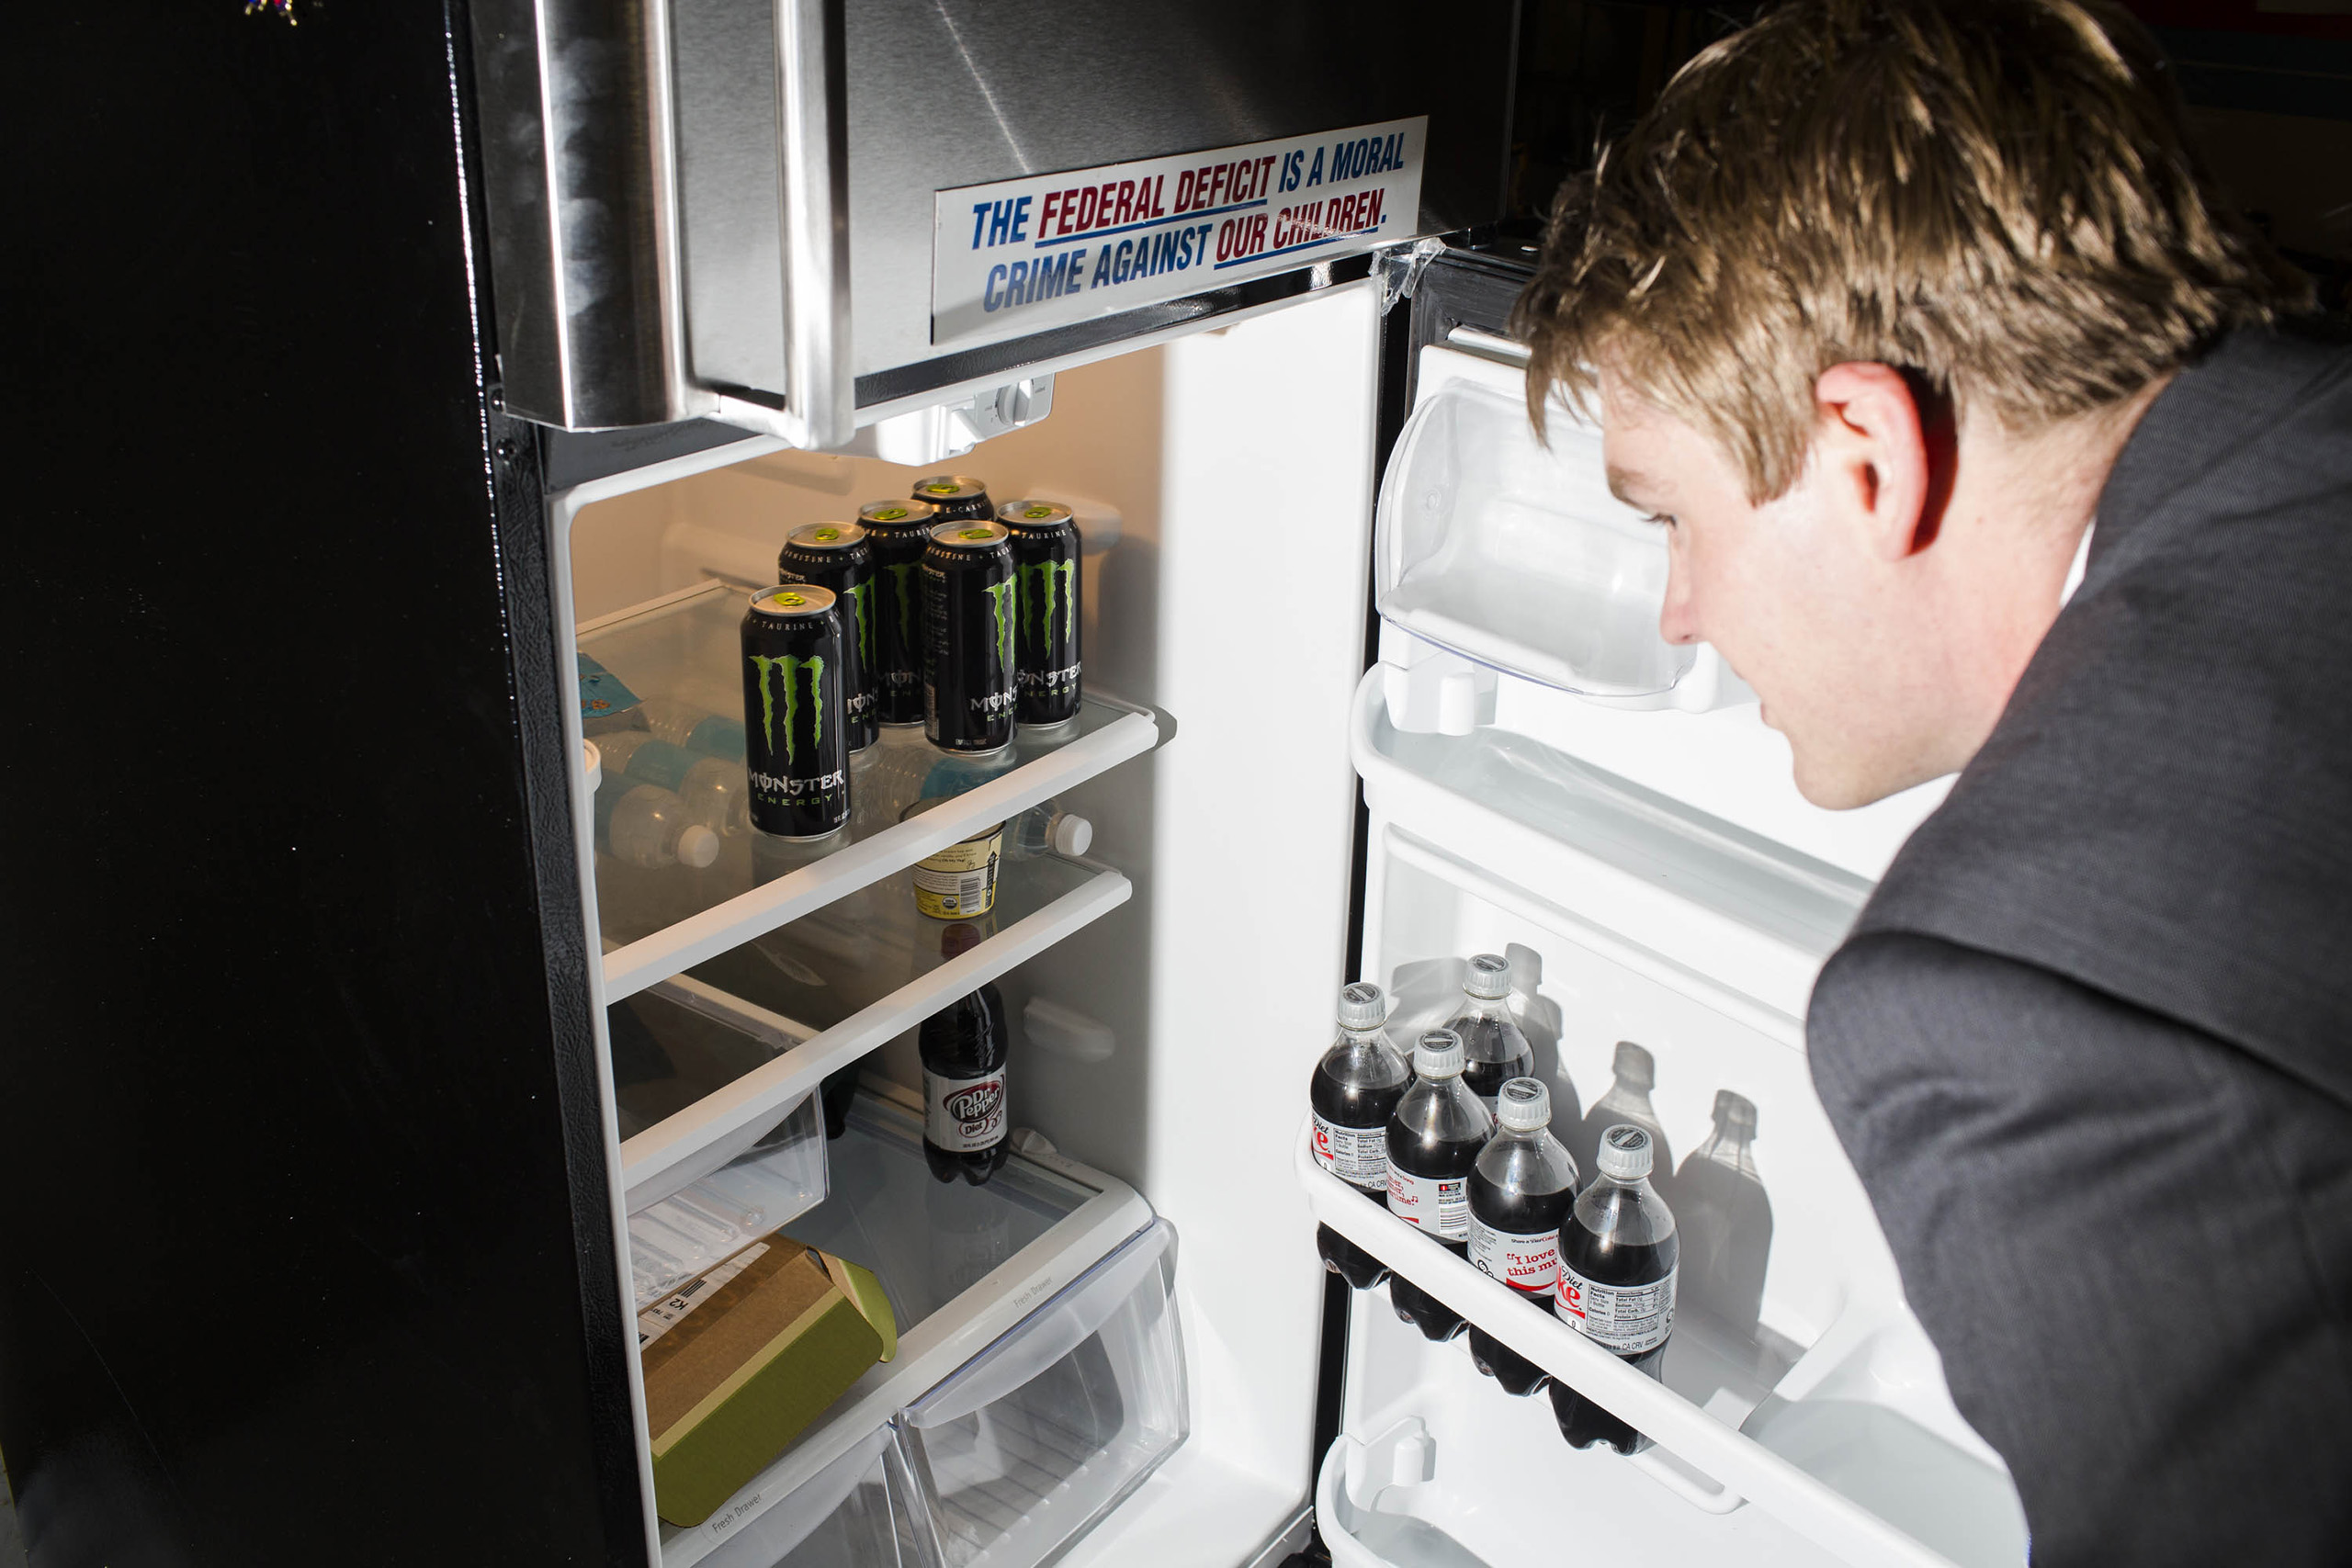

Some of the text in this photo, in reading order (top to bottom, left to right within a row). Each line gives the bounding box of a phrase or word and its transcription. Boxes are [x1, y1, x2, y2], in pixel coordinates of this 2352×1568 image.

[972, 132, 1405, 250] THE FEDERAL DEFICIT IS A MORAL
[983, 188, 1386, 312] CRIME AGAINST OUR CHILDREN.
[1022, 529, 1067, 539] TAURINE
[762, 620, 813, 631] TAURINE
[1017, 660, 1081, 688] ONSTER
[970, 683, 1018, 713] MONS
[1024, 682, 1077, 697] NERGY
[987, 703, 1018, 722] ENE
[748, 768, 844, 796] MONSTER
[757, 793, 832, 807] ENERGY
[958, 1088, 1000, 1120] Pepper
[972, 1088, 990, 1106] Dr
[965, 1122, 983, 1135] Diet
[1313, 1112, 1329, 1134] Diet
[1524, 1248, 1555, 1265] love
[1507, 1257, 1558, 1277] this mu
[1561, 1265, 1583, 1291] Diet
[1590, 1287, 1615, 1296] Nutrition
[669, 1297, 689, 1311] K2
[1589, 1306, 1606, 1315] Calories
[1571, 1319, 1577, 1329] 0
[1622, 1341, 1631, 1351] CA
[1631, 1340, 1644, 1350] CRV
[711, 1493, 762, 1534] Fresh Drawer
